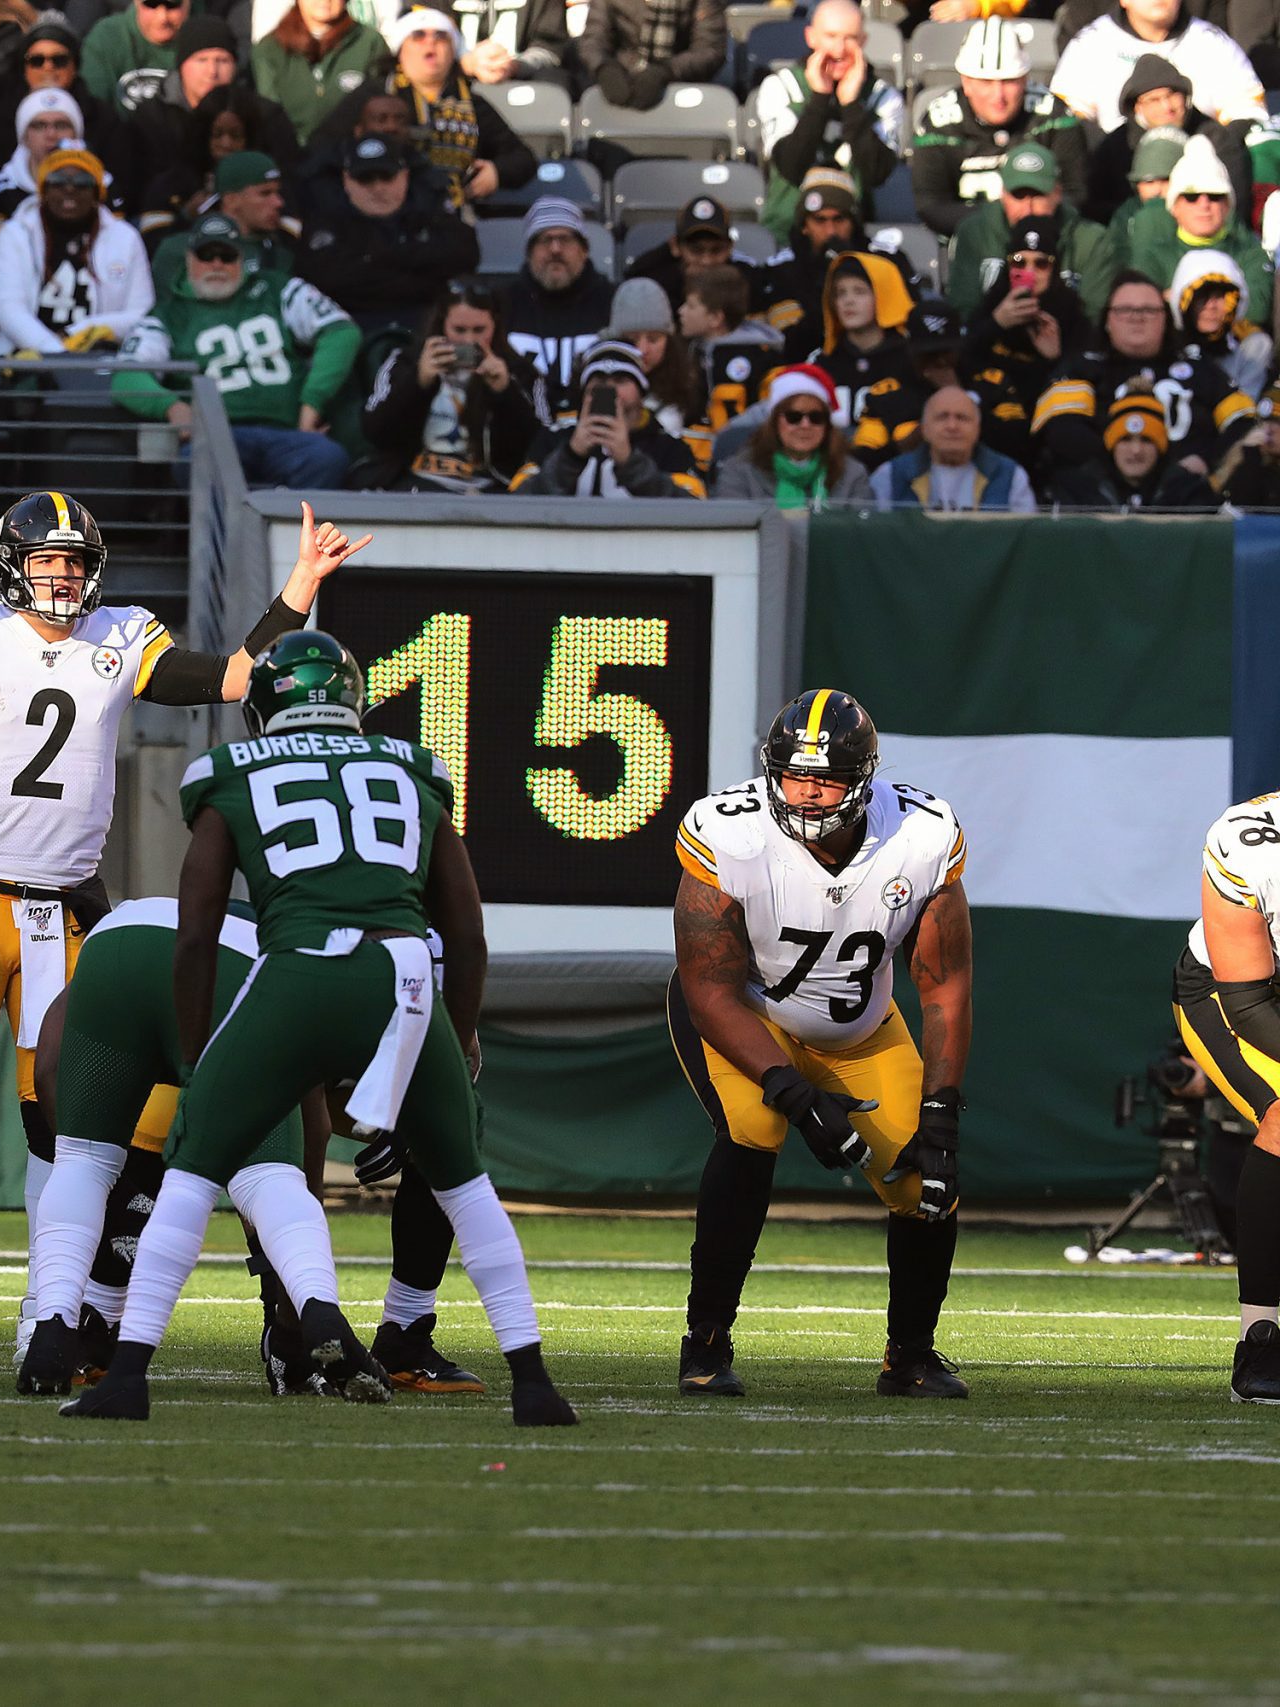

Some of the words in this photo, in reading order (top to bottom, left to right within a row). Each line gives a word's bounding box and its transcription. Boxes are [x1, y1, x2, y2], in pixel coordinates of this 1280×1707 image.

[195, 313, 292, 393] 28
[285, 711, 314, 721] NEW
[317, 711, 347, 720] YORK
[307, 689, 327, 703] 58
[368, 612, 673, 840] 15
[9, 687, 77, 800] 2
[228, 732, 372, 768] BURGESS
[379, 735, 416, 764] JR
[247, 761, 422, 880] 58
[892, 783, 944, 819] 73
[762, 926, 886, 1024] 73
